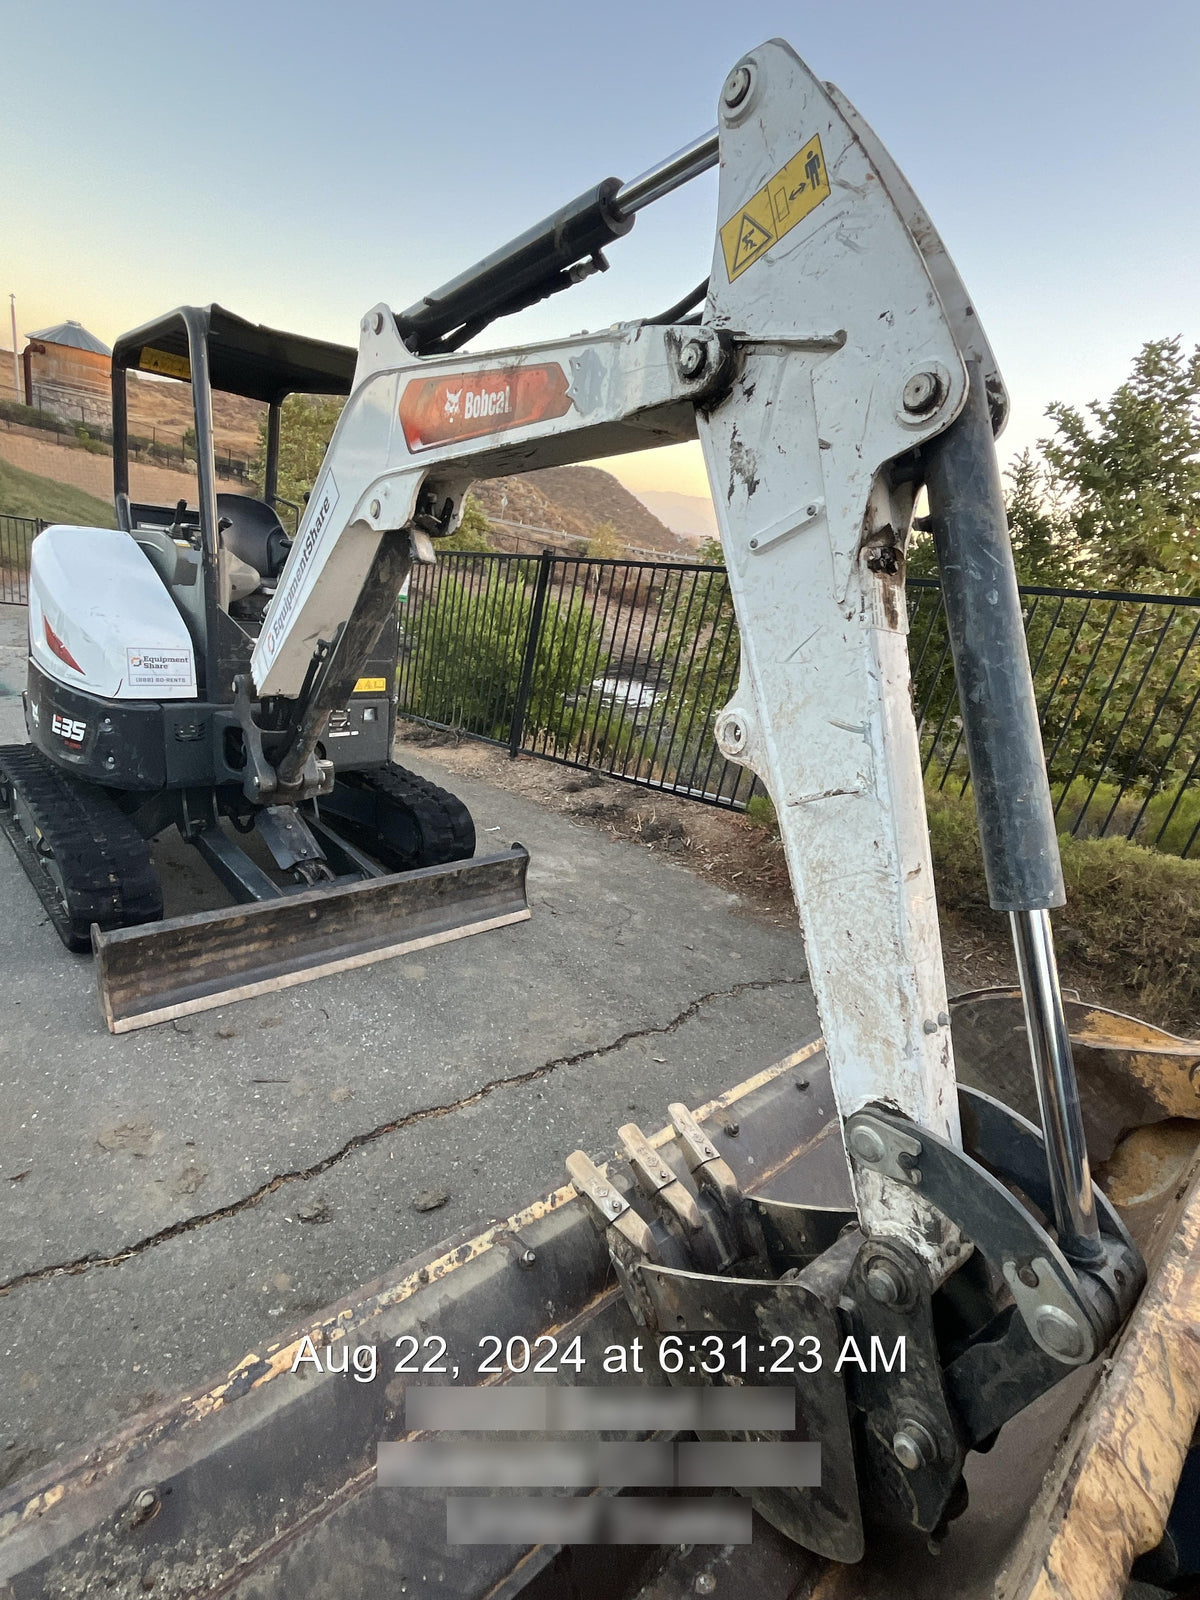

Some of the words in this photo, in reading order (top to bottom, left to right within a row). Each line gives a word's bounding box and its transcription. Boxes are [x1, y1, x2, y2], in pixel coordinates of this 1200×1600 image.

[464, 385, 511, 419] Bobcat
[273, 498, 331, 640] EquipmentShare
[143, 655, 189, 665] Equipment
[143, 662, 169, 670] Share
[51, 713, 87, 742] E35
